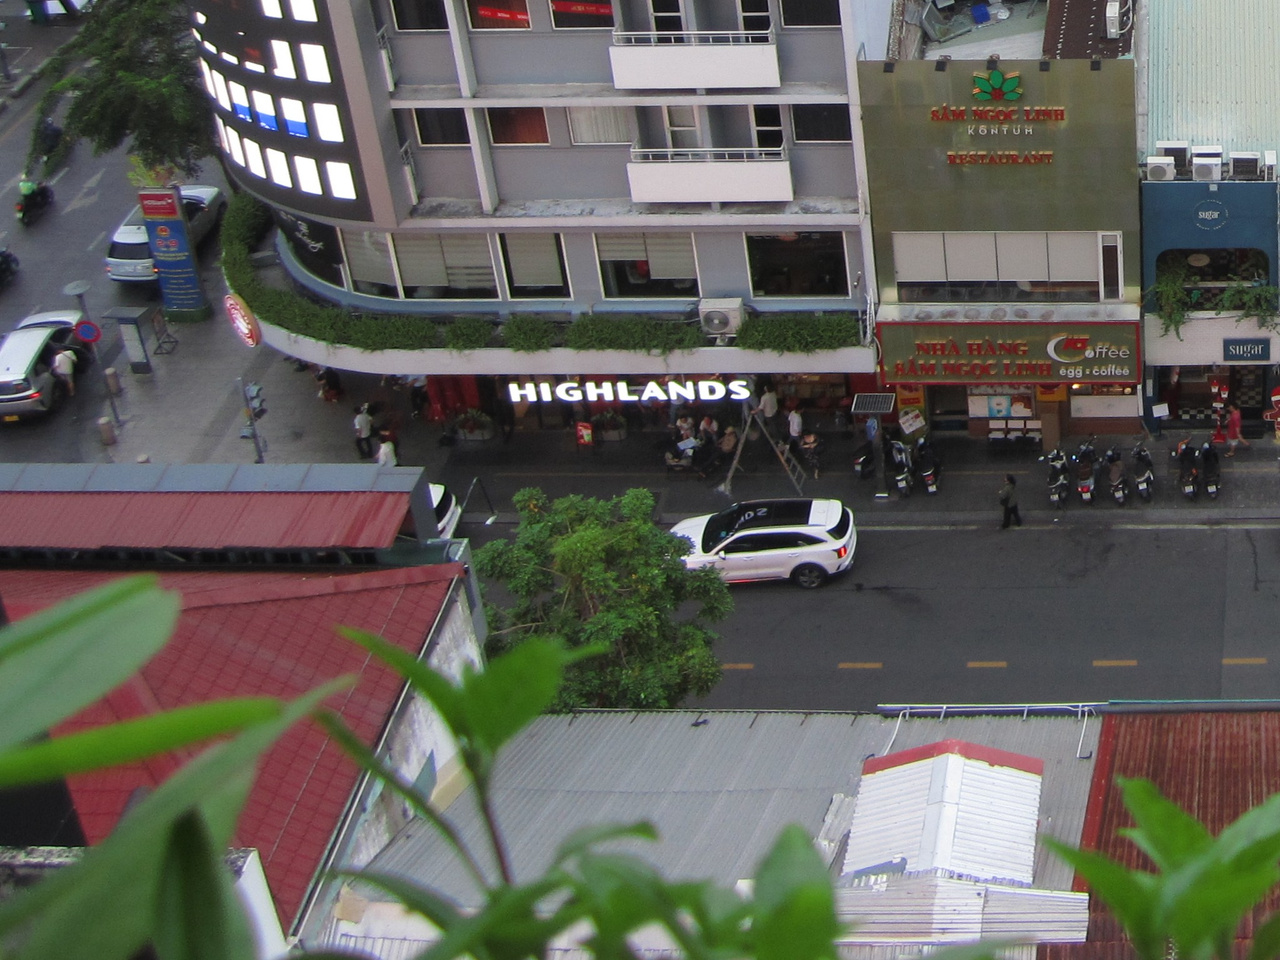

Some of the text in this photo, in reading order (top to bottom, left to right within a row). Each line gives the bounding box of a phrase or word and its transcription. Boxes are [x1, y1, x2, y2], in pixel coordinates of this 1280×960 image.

[1024, 106, 1065, 121] LINH
[947, 151, 1053, 164] RESTAURANT
[1198, 210, 1220, 220] sugar
[915, 336, 1029, 356] NHÀ HÀNG
[1229, 343, 1264, 357] sugar
[1002, 359, 1053, 376] LINH
[1060, 364, 1130, 378] egg coffee
[508, 380, 750, 402] HIGHLANDS
